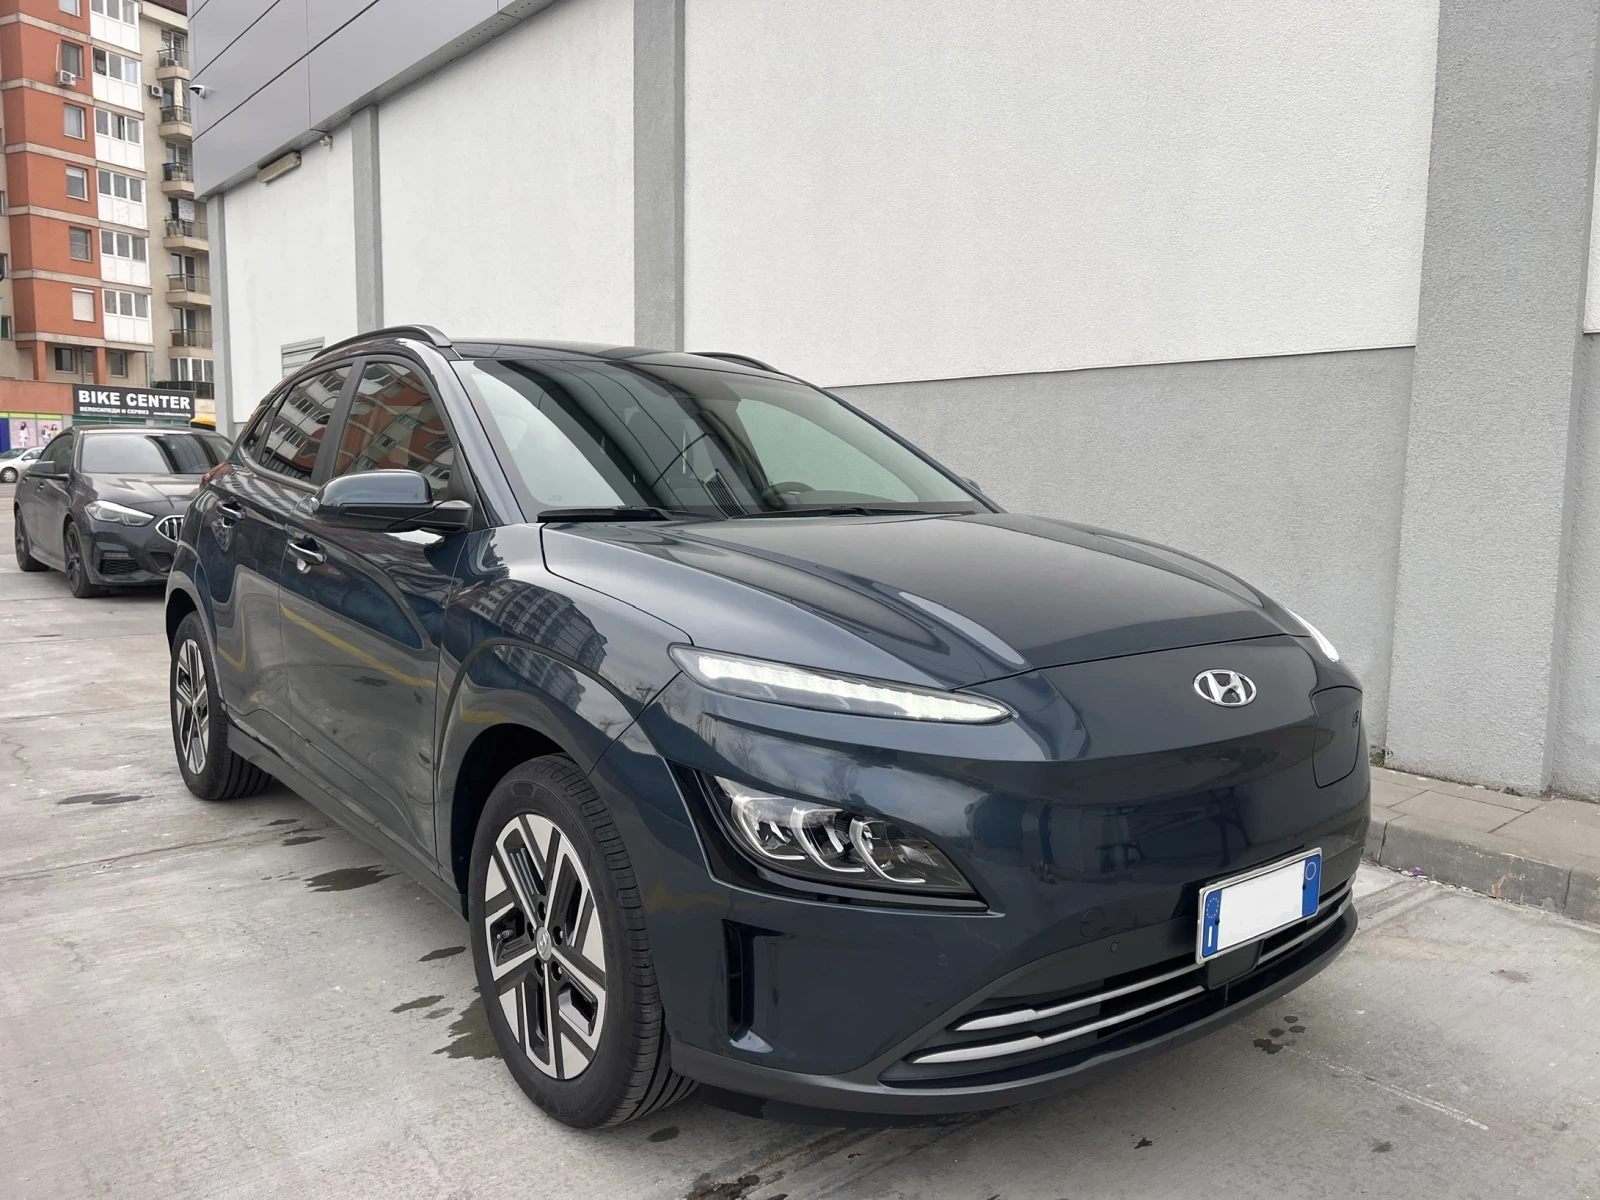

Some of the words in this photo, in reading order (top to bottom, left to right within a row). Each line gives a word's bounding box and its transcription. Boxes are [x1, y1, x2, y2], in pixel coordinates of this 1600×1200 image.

[79, 390, 120, 405] BIKE
[126, 393, 191, 409] CENTER
[80, 406, 120, 414] ВЕЛОСИПЕДИ
